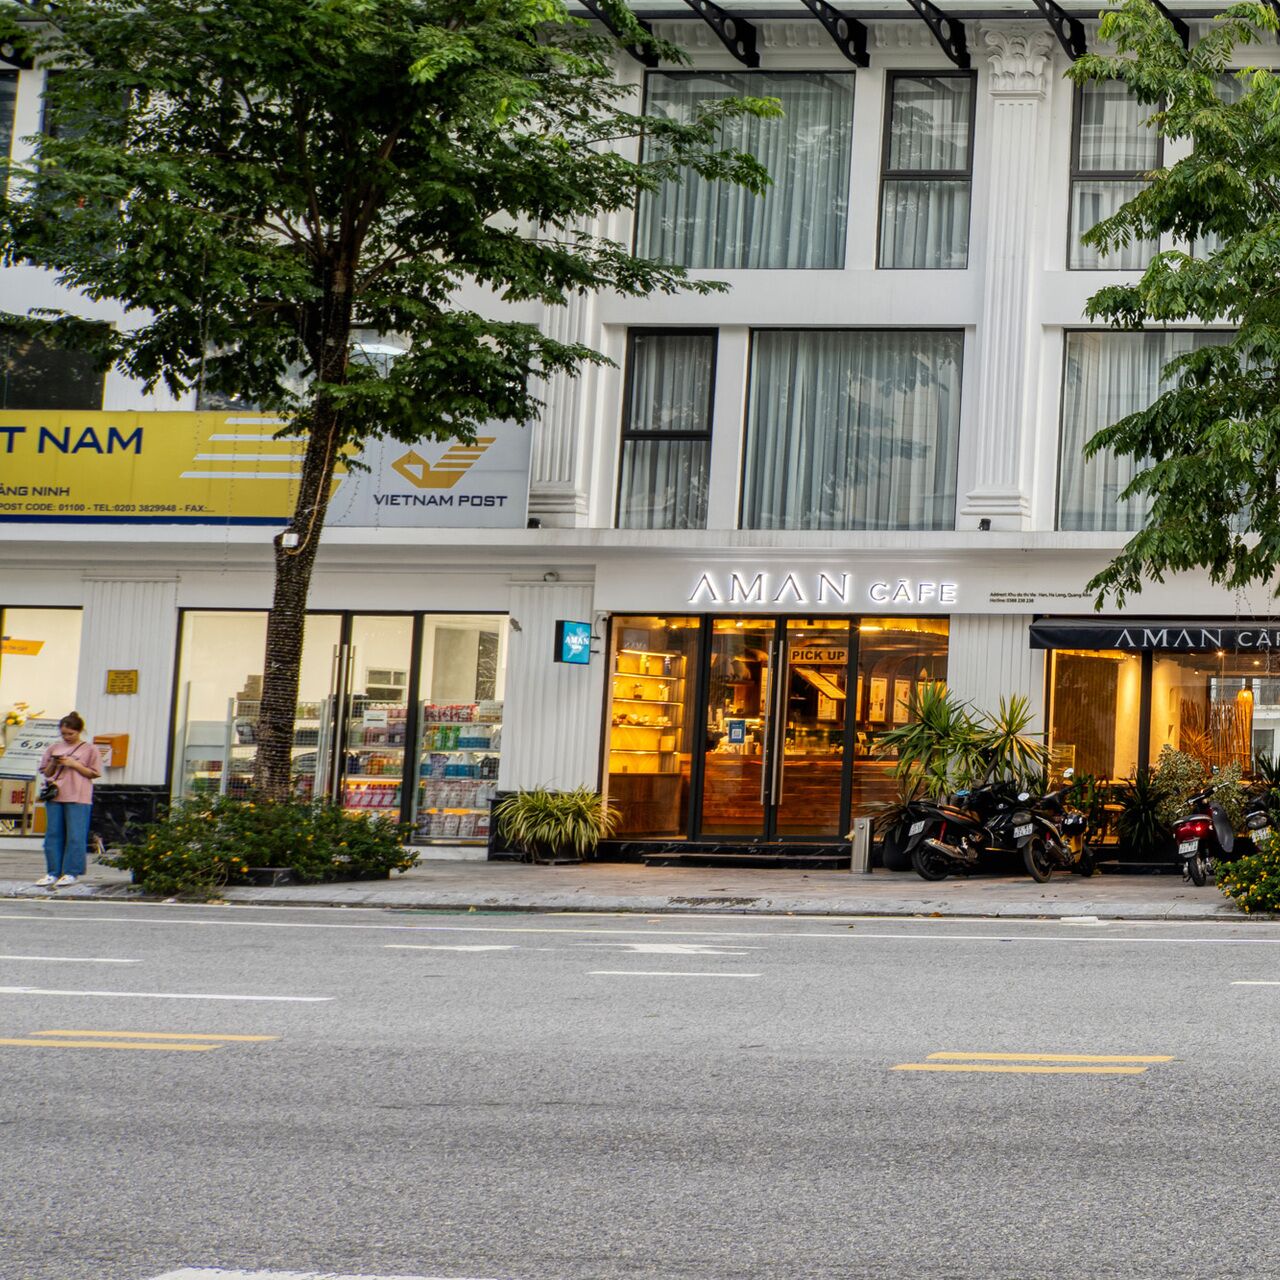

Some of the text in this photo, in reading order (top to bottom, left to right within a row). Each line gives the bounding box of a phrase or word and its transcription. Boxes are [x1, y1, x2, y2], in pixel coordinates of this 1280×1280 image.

[38, 427, 143, 454] NAM
[32, 486, 70, 496] NINH
[373, 494, 507, 507] VIETNAM POST
[688, 572, 851, 603] AMAN
[565, 635, 589, 645] AMAN
[1114, 628, 1223, 647] AMAN
[792, 650, 845, 661] PICK UP
